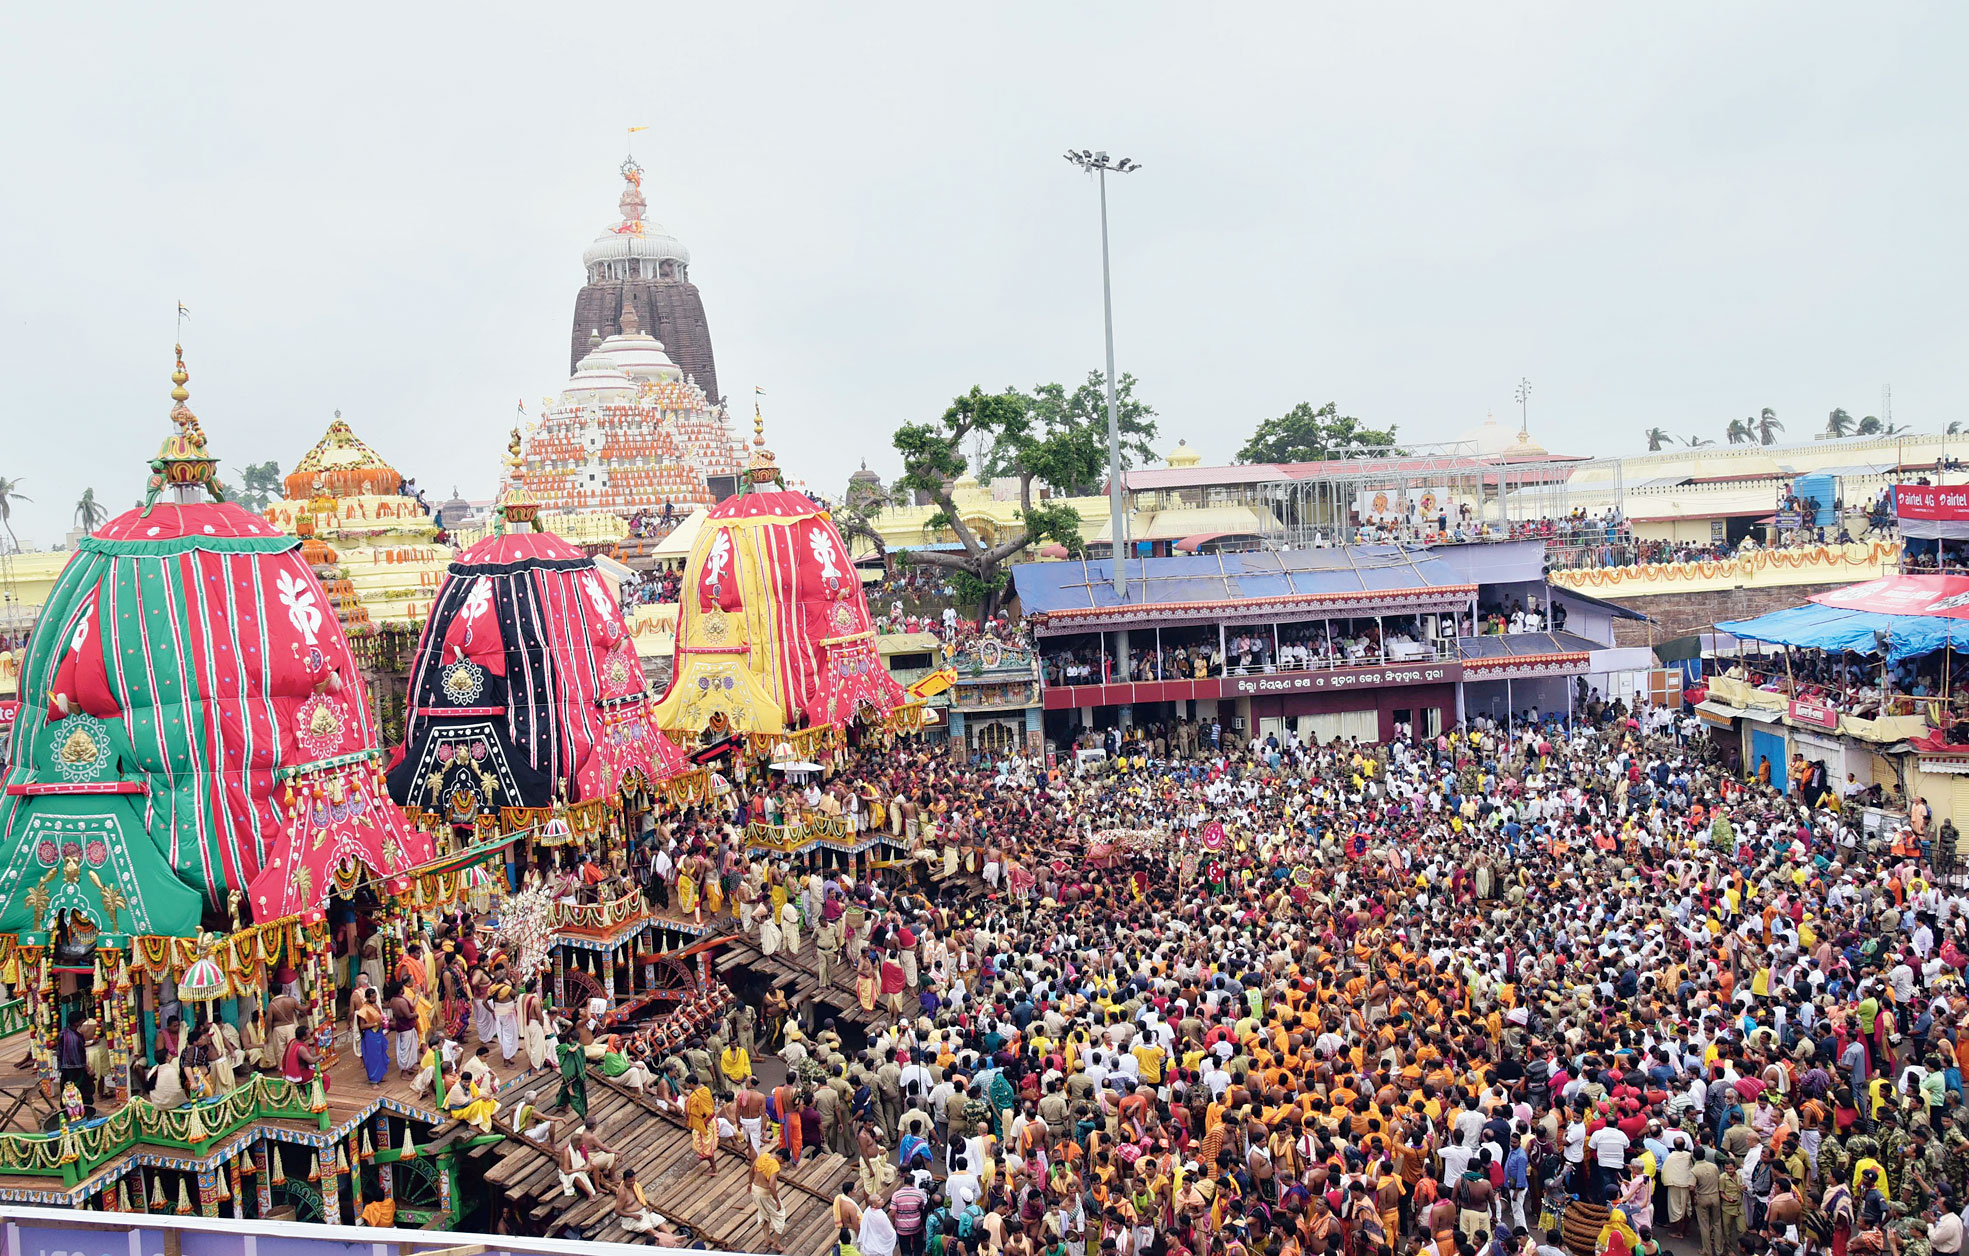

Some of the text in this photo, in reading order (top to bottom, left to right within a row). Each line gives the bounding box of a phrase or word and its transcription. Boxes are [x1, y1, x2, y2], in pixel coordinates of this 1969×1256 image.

[1905, 492, 1935, 507] airtel 4G
[1946, 492, 1968, 506] airtel
[1316, 678, 1324, 686] ଓ
